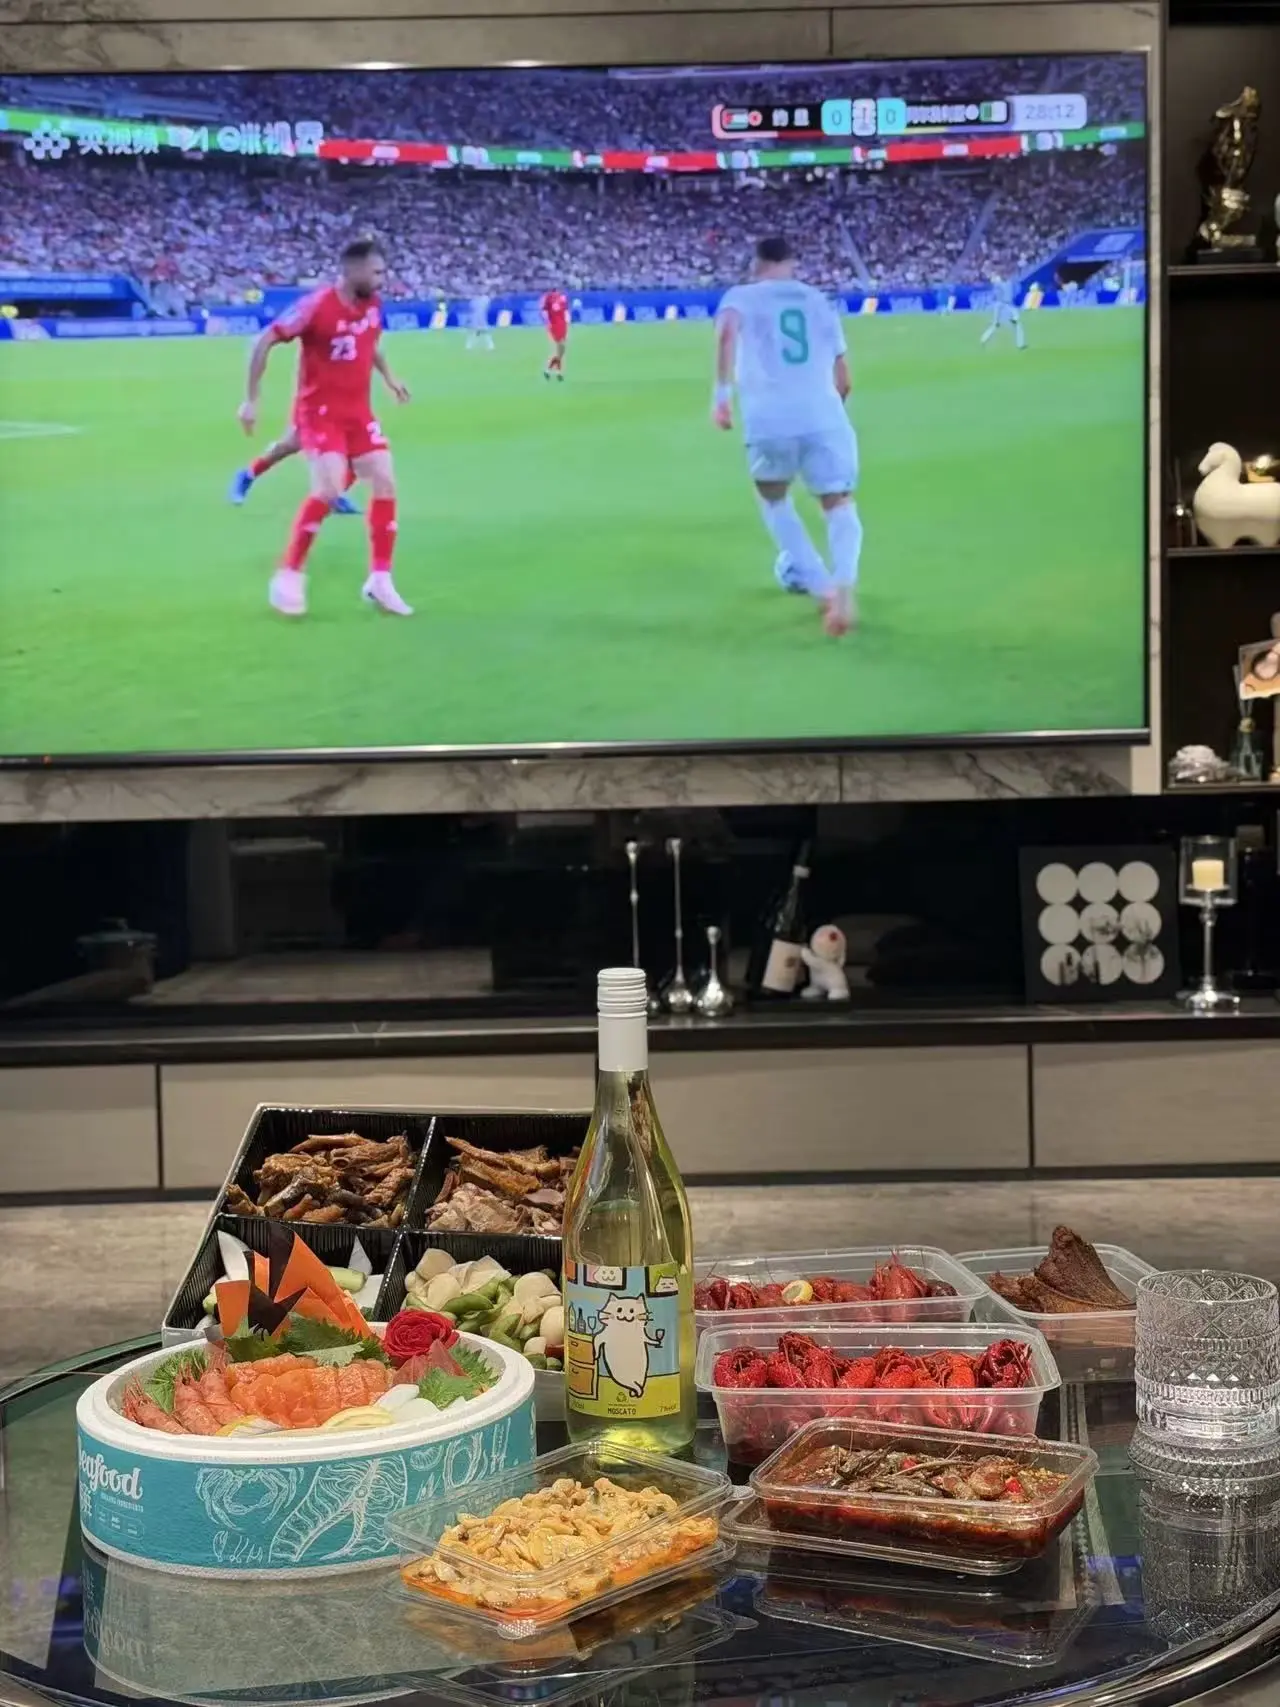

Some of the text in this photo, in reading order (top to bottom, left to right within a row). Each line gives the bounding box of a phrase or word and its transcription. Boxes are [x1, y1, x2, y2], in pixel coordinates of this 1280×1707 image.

[831, 109, 843, 127] 0
[885, 108, 897, 125] 0
[780, 309, 809, 364] 9
[330, 335, 357, 361] 23
[607, 1407, 637, 1416] MOSCATO
[79, 1450, 143, 1500] eafood
